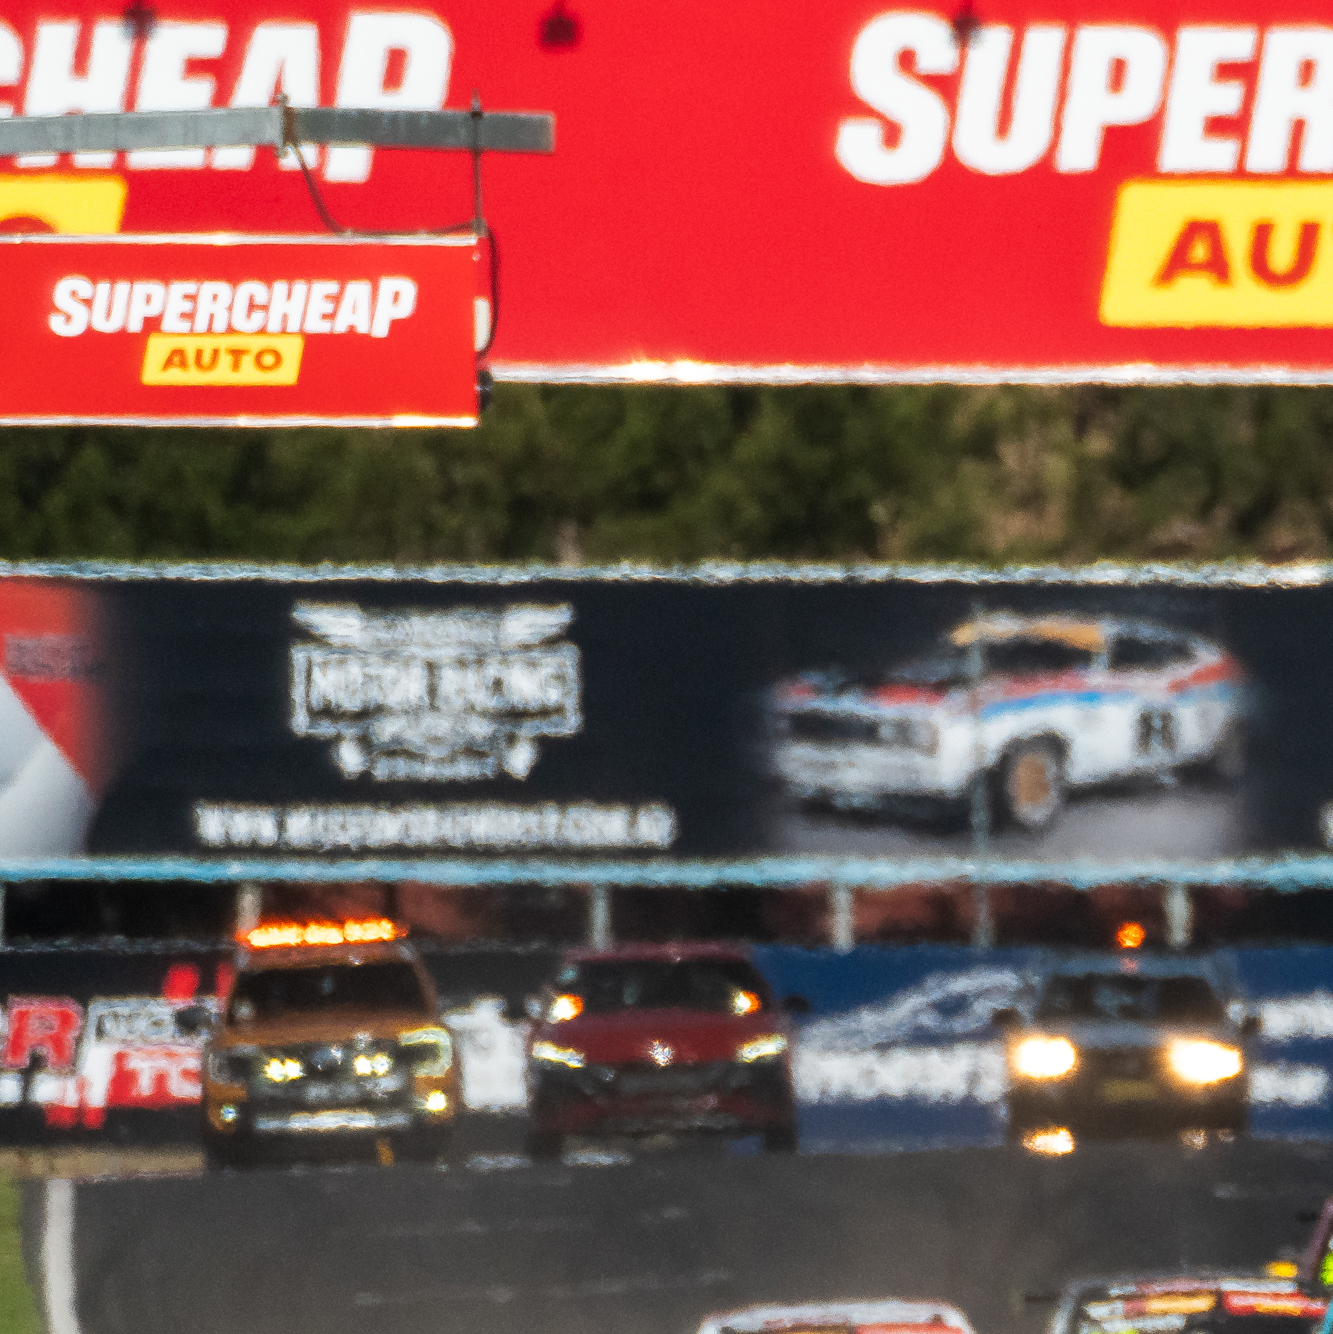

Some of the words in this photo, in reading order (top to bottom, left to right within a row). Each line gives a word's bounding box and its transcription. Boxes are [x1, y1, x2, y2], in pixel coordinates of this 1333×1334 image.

[0, 10, 453, 183] HEAP
[48, 276, 417, 338] SUPERCHEAP
[160, 346, 284, 374] AUTO
